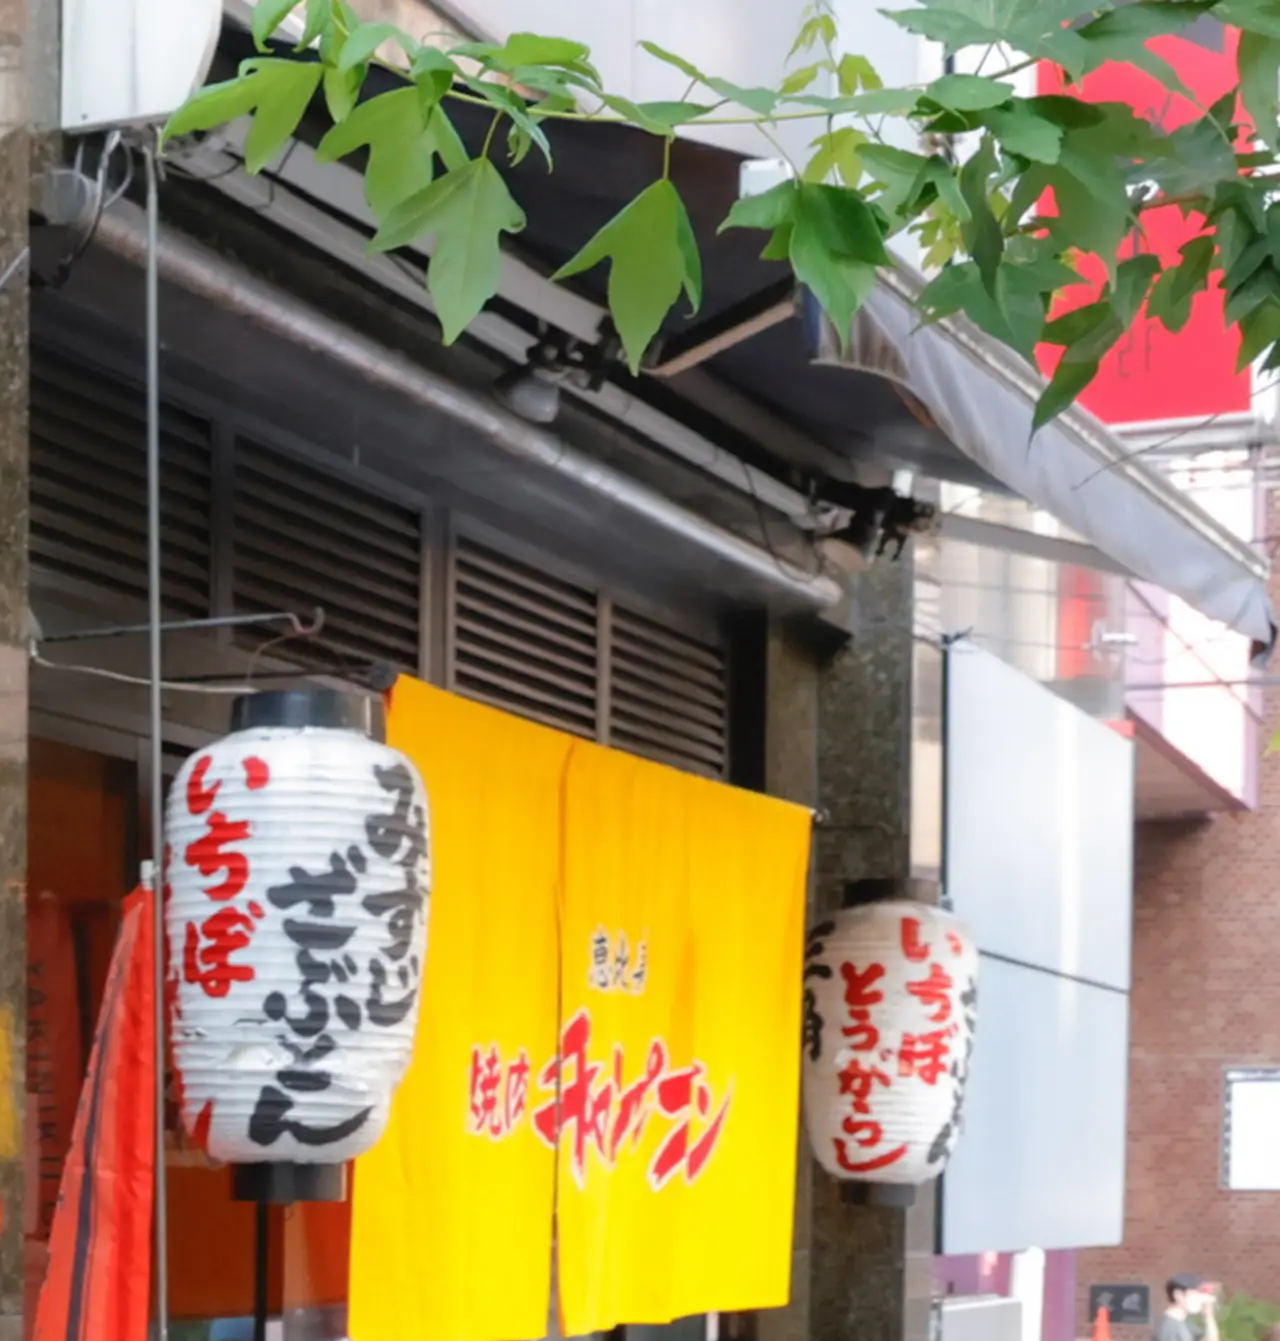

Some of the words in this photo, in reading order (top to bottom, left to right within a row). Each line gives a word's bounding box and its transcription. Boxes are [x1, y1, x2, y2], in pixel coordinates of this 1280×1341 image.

[185, 754, 270, 998] いちぼ
[831, 960, 909, 1173] とうがらし
[897, 916, 963, 1086] いちぼ
